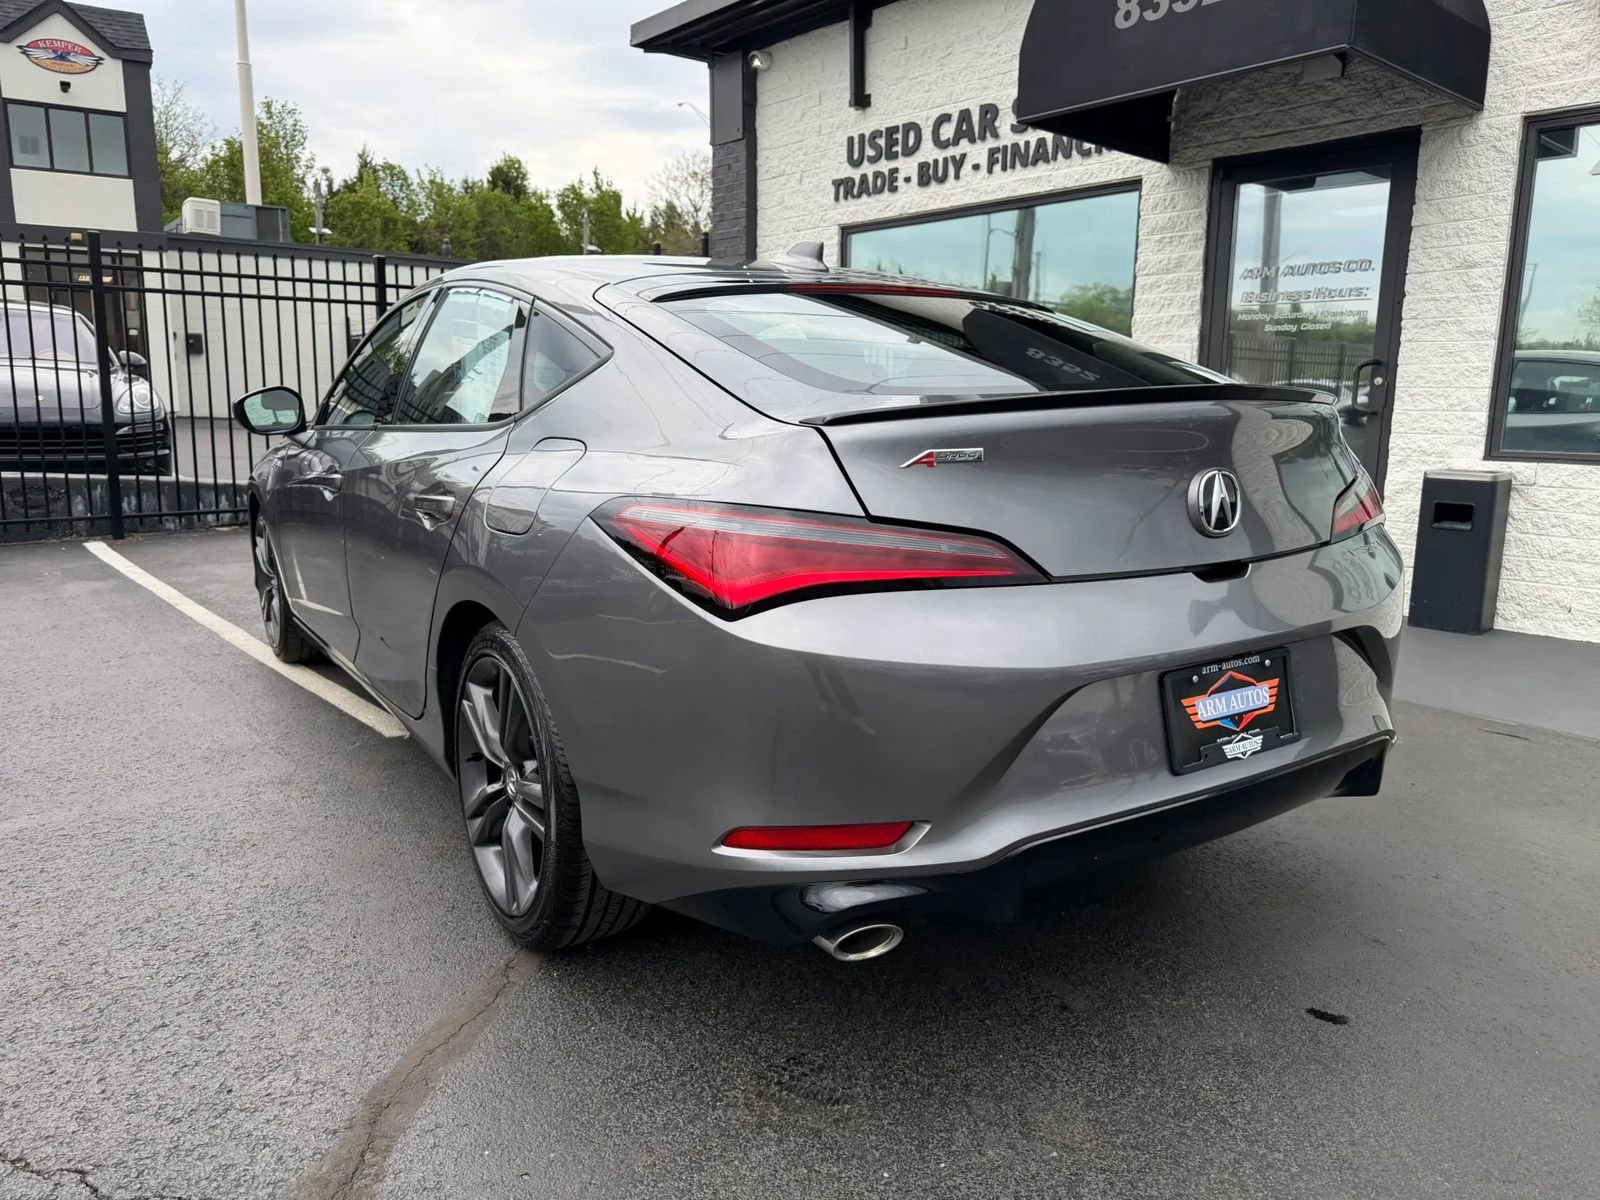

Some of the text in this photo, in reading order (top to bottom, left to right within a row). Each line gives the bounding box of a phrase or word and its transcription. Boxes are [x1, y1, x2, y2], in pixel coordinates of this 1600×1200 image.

[38, 40, 82, 53] KEMPER
[846, 121, 922, 168] USED
[931, 103, 999, 149] CAR
[832, 167, 899, 201] TRADE
[917, 153, 967, 187] BUY
[1239, 265, 1279, 281] ARM
[1279, 260, 1342, 278] AUTOS
[1240, 289, 1312, 303] Business
[1264, 322, 1332, 333] Sunday Closed
[1201, 655, 1260, 675] arm-autos.com
[1197, 687, 1270, 718] ARM AUTOS
